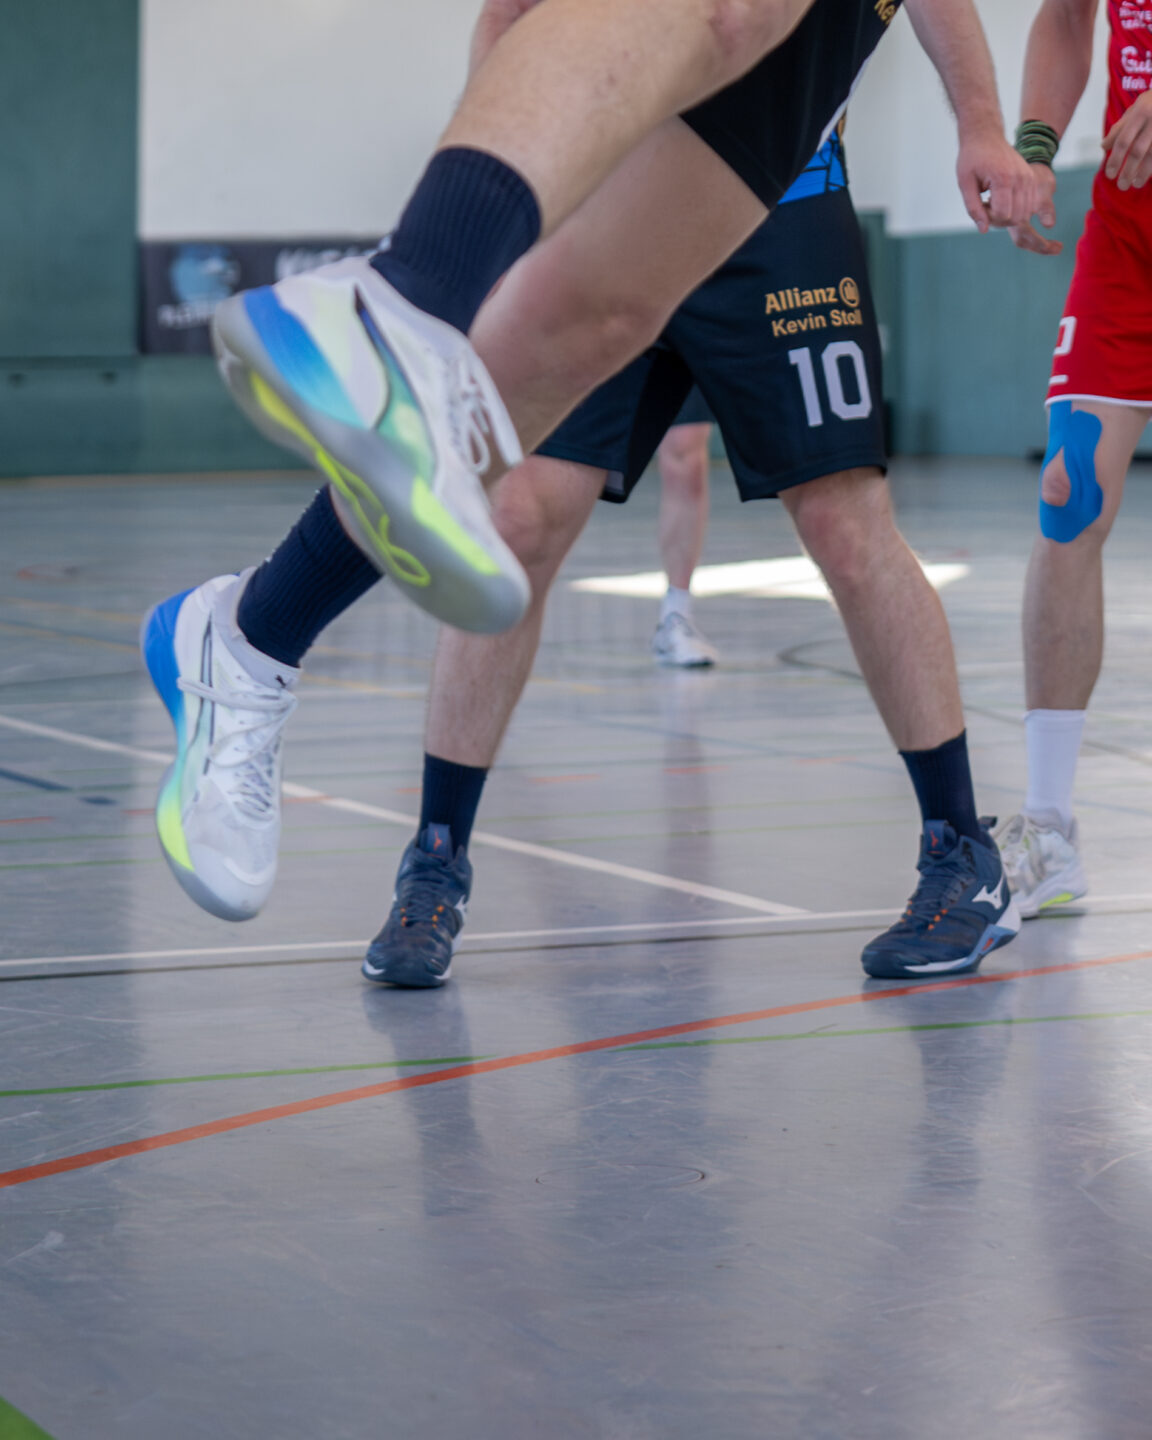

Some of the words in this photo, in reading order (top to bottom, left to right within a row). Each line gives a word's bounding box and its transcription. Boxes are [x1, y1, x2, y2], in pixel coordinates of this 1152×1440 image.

[765, 288, 838, 315] Allianz
[772, 313, 827, 338] Kevin
[788, 340, 873, 427] 10
